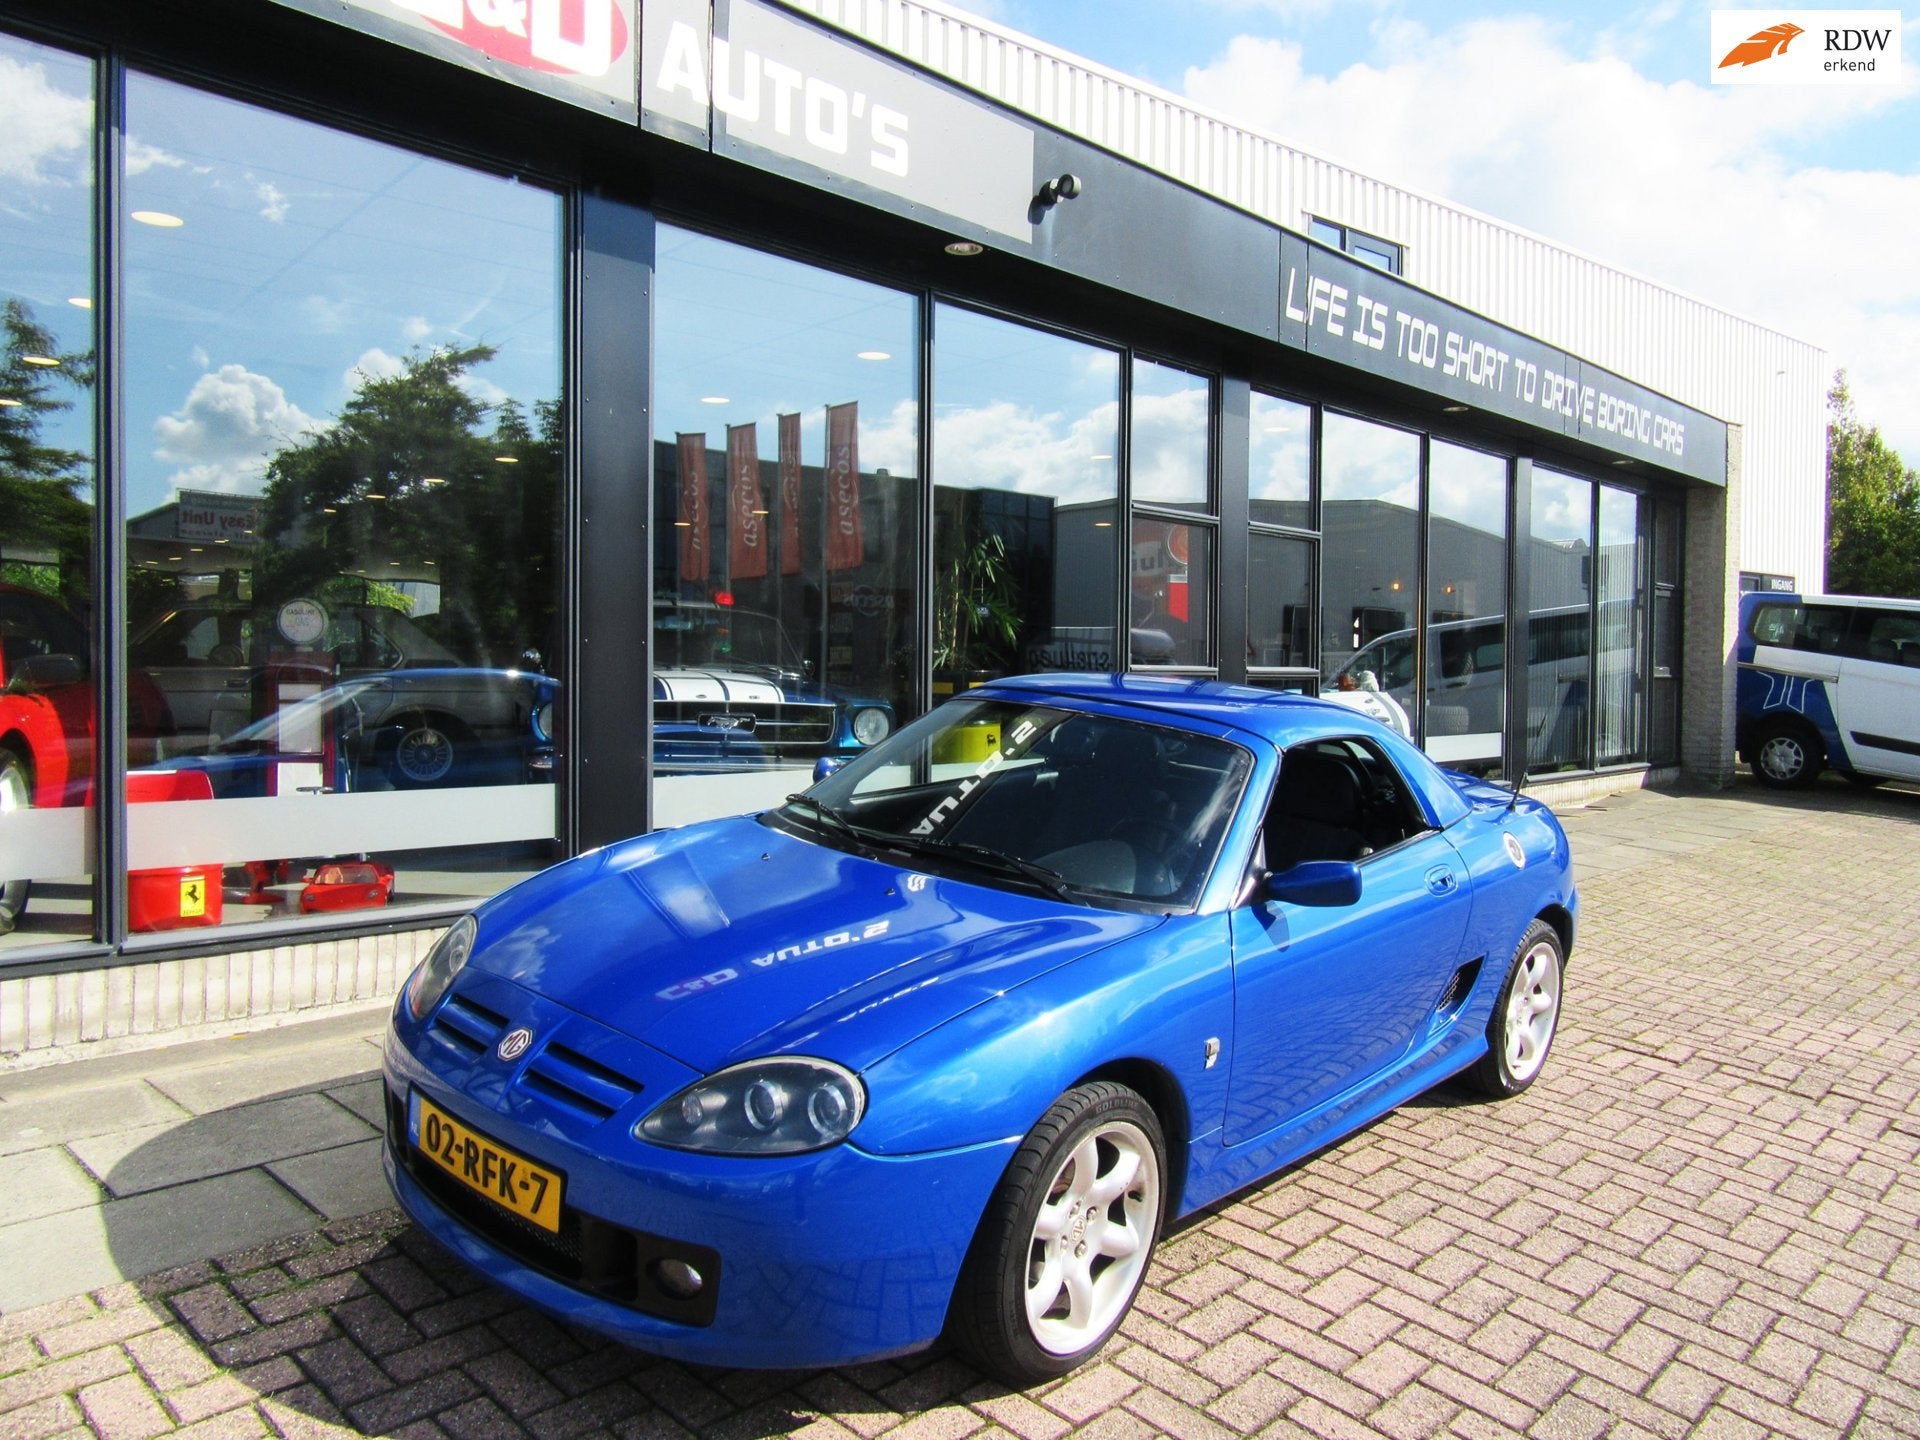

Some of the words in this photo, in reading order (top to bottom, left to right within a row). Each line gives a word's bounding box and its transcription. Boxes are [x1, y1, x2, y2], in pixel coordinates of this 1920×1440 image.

[656, 20, 909, 177] AUTO'S
[1285, 267, 1348, 337] LIFE
[1352, 295, 1388, 350] IS
[1396, 311, 1439, 369] TOO
[1443, 331, 1509, 393] SHORT
[1515, 358, 1537, 404] TO
[1541, 369, 1596, 430] DRIVE
[1597, 391, 1650, 445] BORING
[1653, 414, 1685, 457] CARS
[1771, 579, 1793, 591] INGANG
[502, 1031, 527, 1054] MG
[426, 1112, 549, 1215] 02-RFK-7
